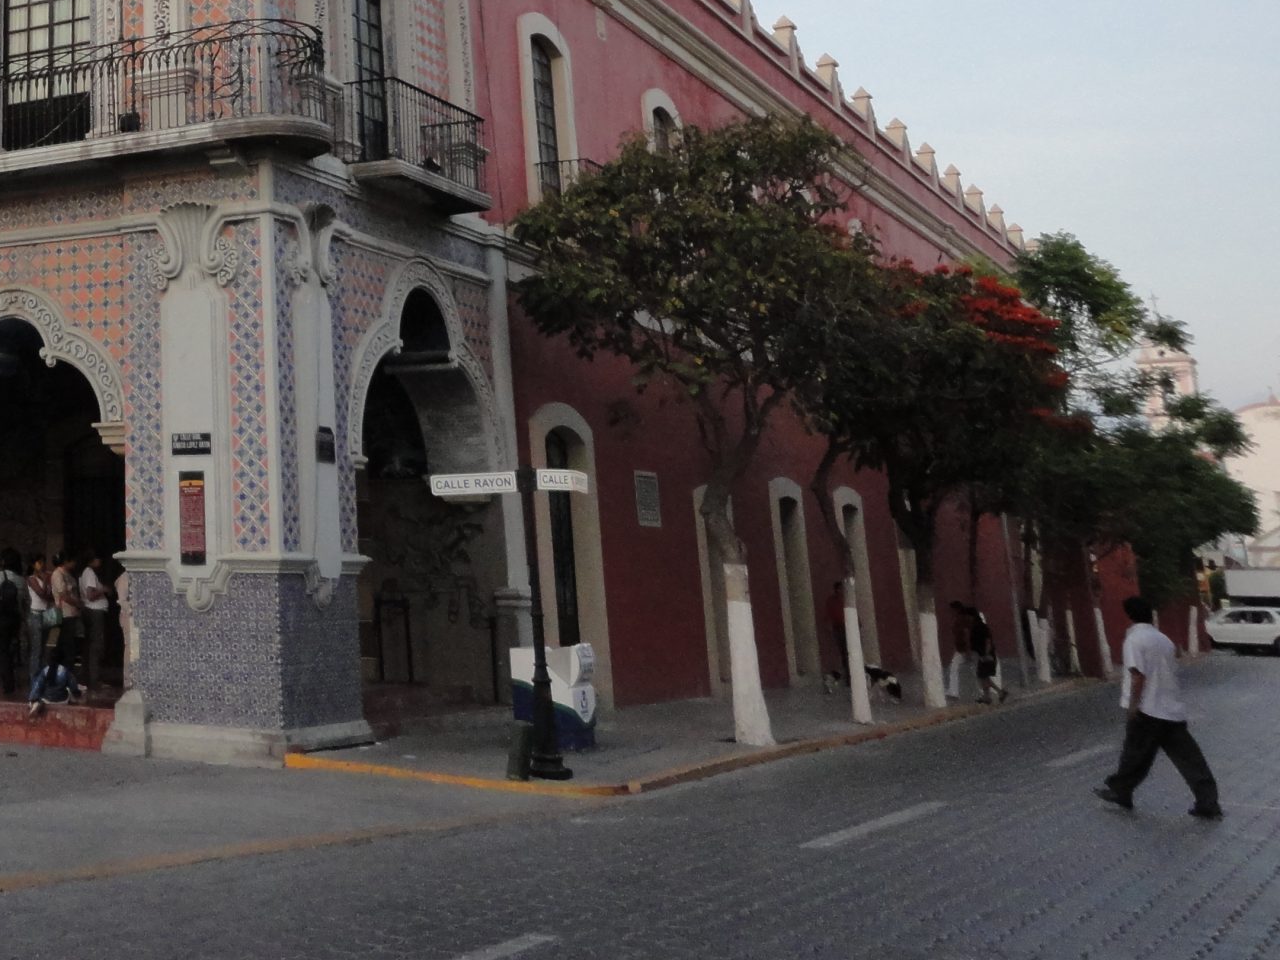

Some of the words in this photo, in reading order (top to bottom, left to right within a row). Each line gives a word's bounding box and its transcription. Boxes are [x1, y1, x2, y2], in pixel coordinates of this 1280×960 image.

[435, 478, 470, 490] CALLE
[474, 476, 512, 488] RAYON
[542, 474, 569, 485] CALLE
